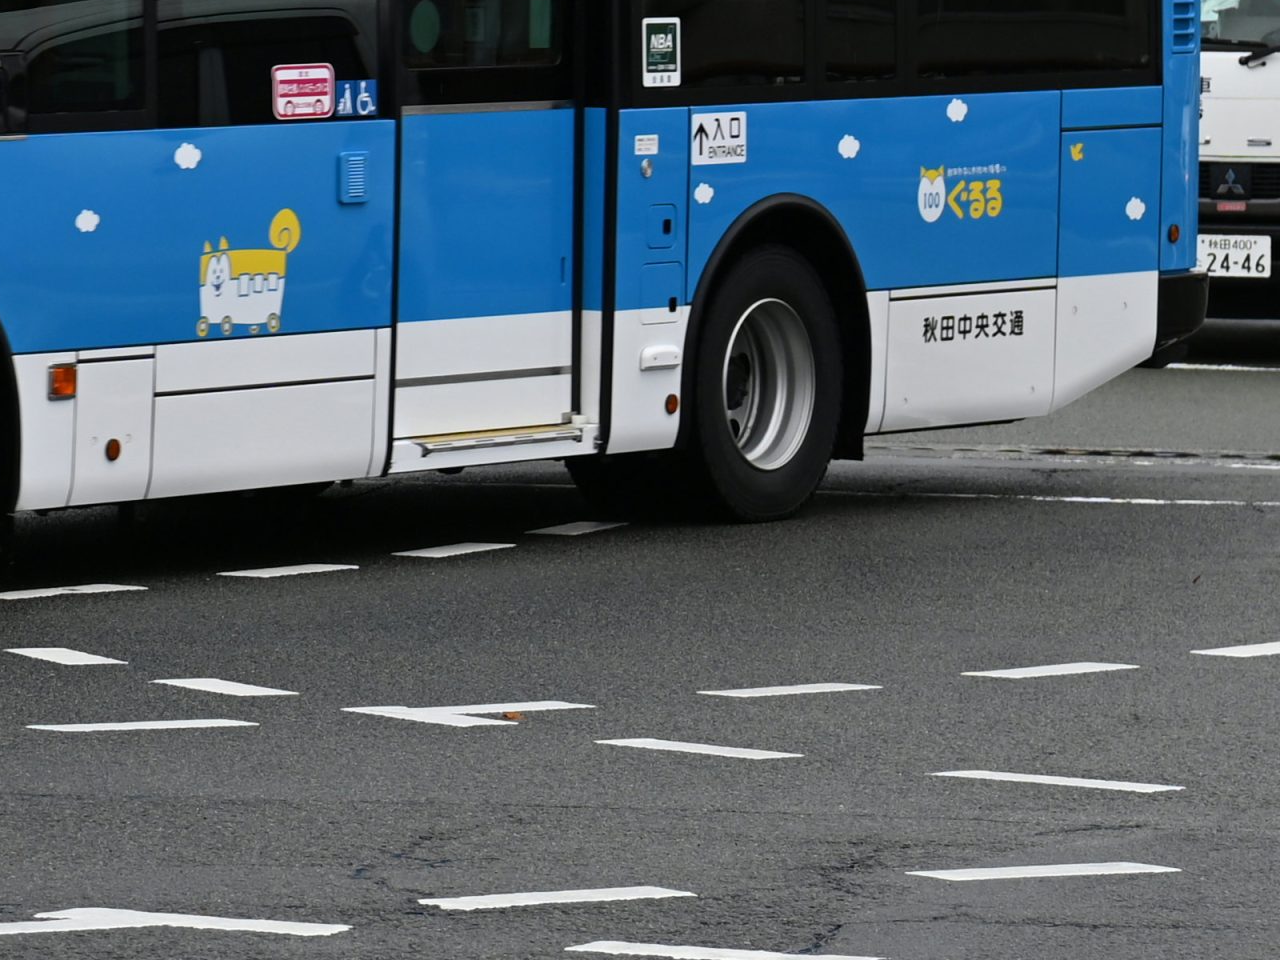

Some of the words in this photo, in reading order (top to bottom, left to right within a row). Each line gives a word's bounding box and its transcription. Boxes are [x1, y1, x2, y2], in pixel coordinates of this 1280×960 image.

[650, 33, 673, 50] NBA
[713, 117, 741, 141] 入口
[708, 144, 745, 158] ENTRANCE
[923, 191, 941, 209] 100
[947, 179, 1003, 219] ぐるる
[1206, 252, 1266, 274] 24-46
[922, 310, 1024, 343] 秋田中央交通
